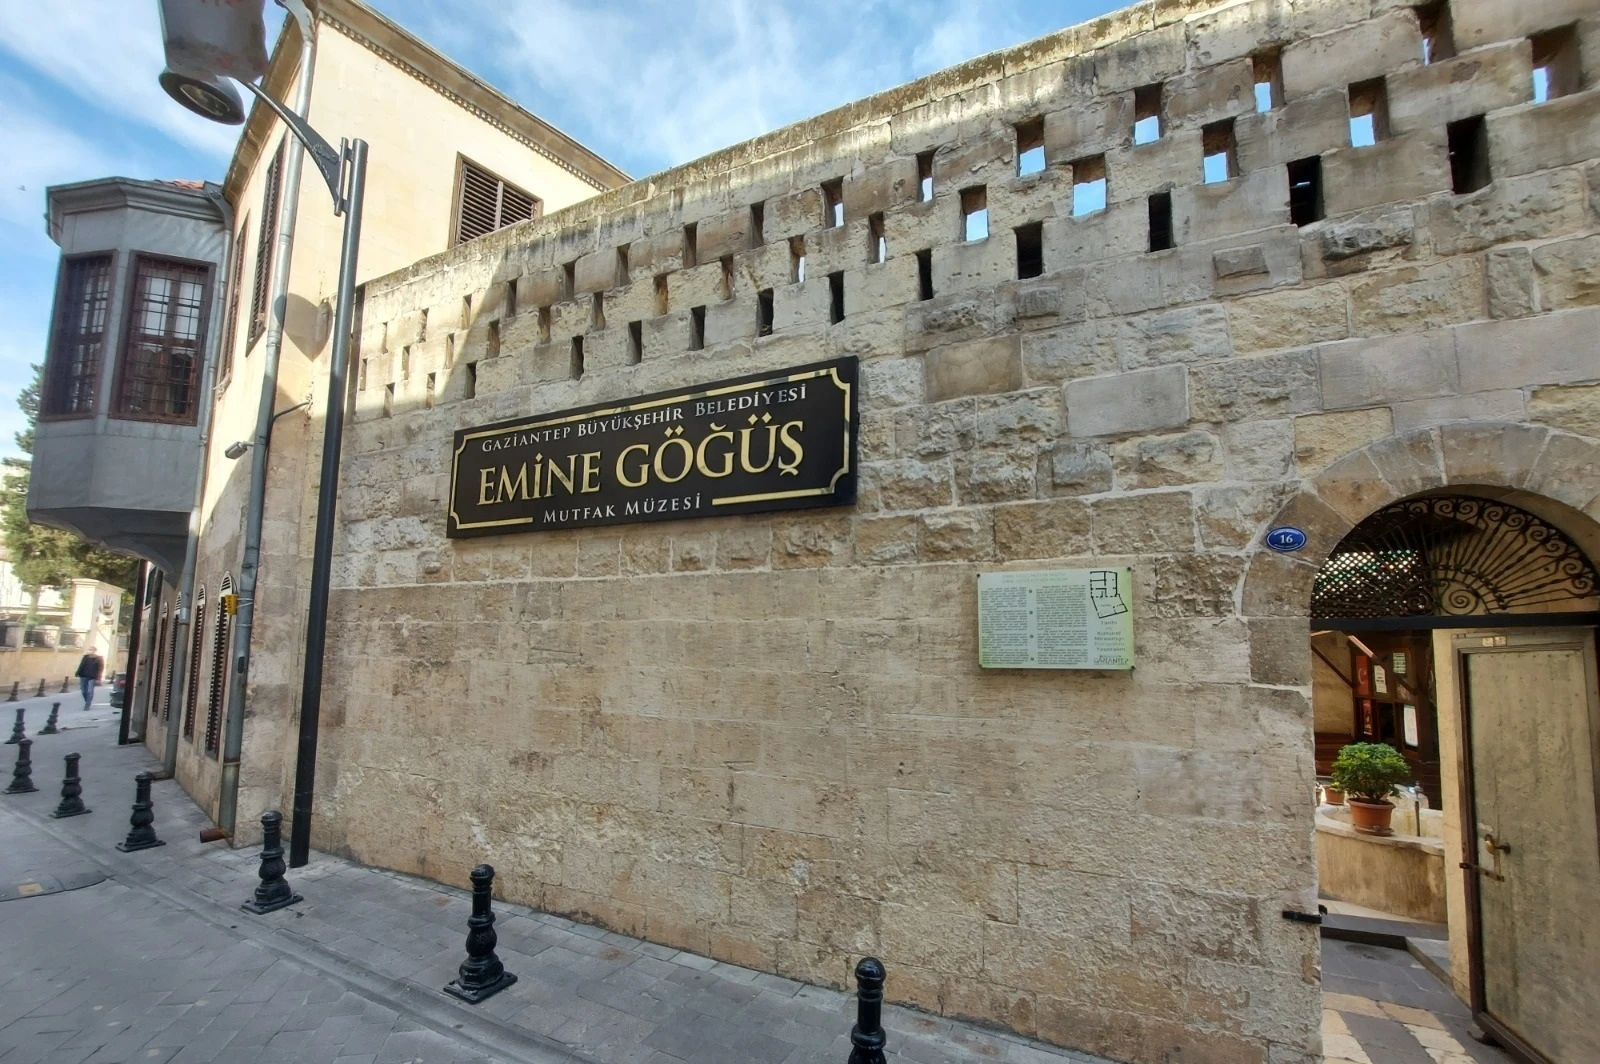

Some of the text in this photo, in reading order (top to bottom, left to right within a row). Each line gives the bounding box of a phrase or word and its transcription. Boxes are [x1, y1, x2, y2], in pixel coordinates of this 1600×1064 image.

[482, 383, 807, 452] GAZİANTEP BÜYÜKŞEHİR BELEDİYESİ
[476, 411, 804, 506] EMİNE GÖĞÜŞ
[543, 492, 701, 523] MUTFAK MÜZESİ
[1280, 534, 1293, 544] 16
